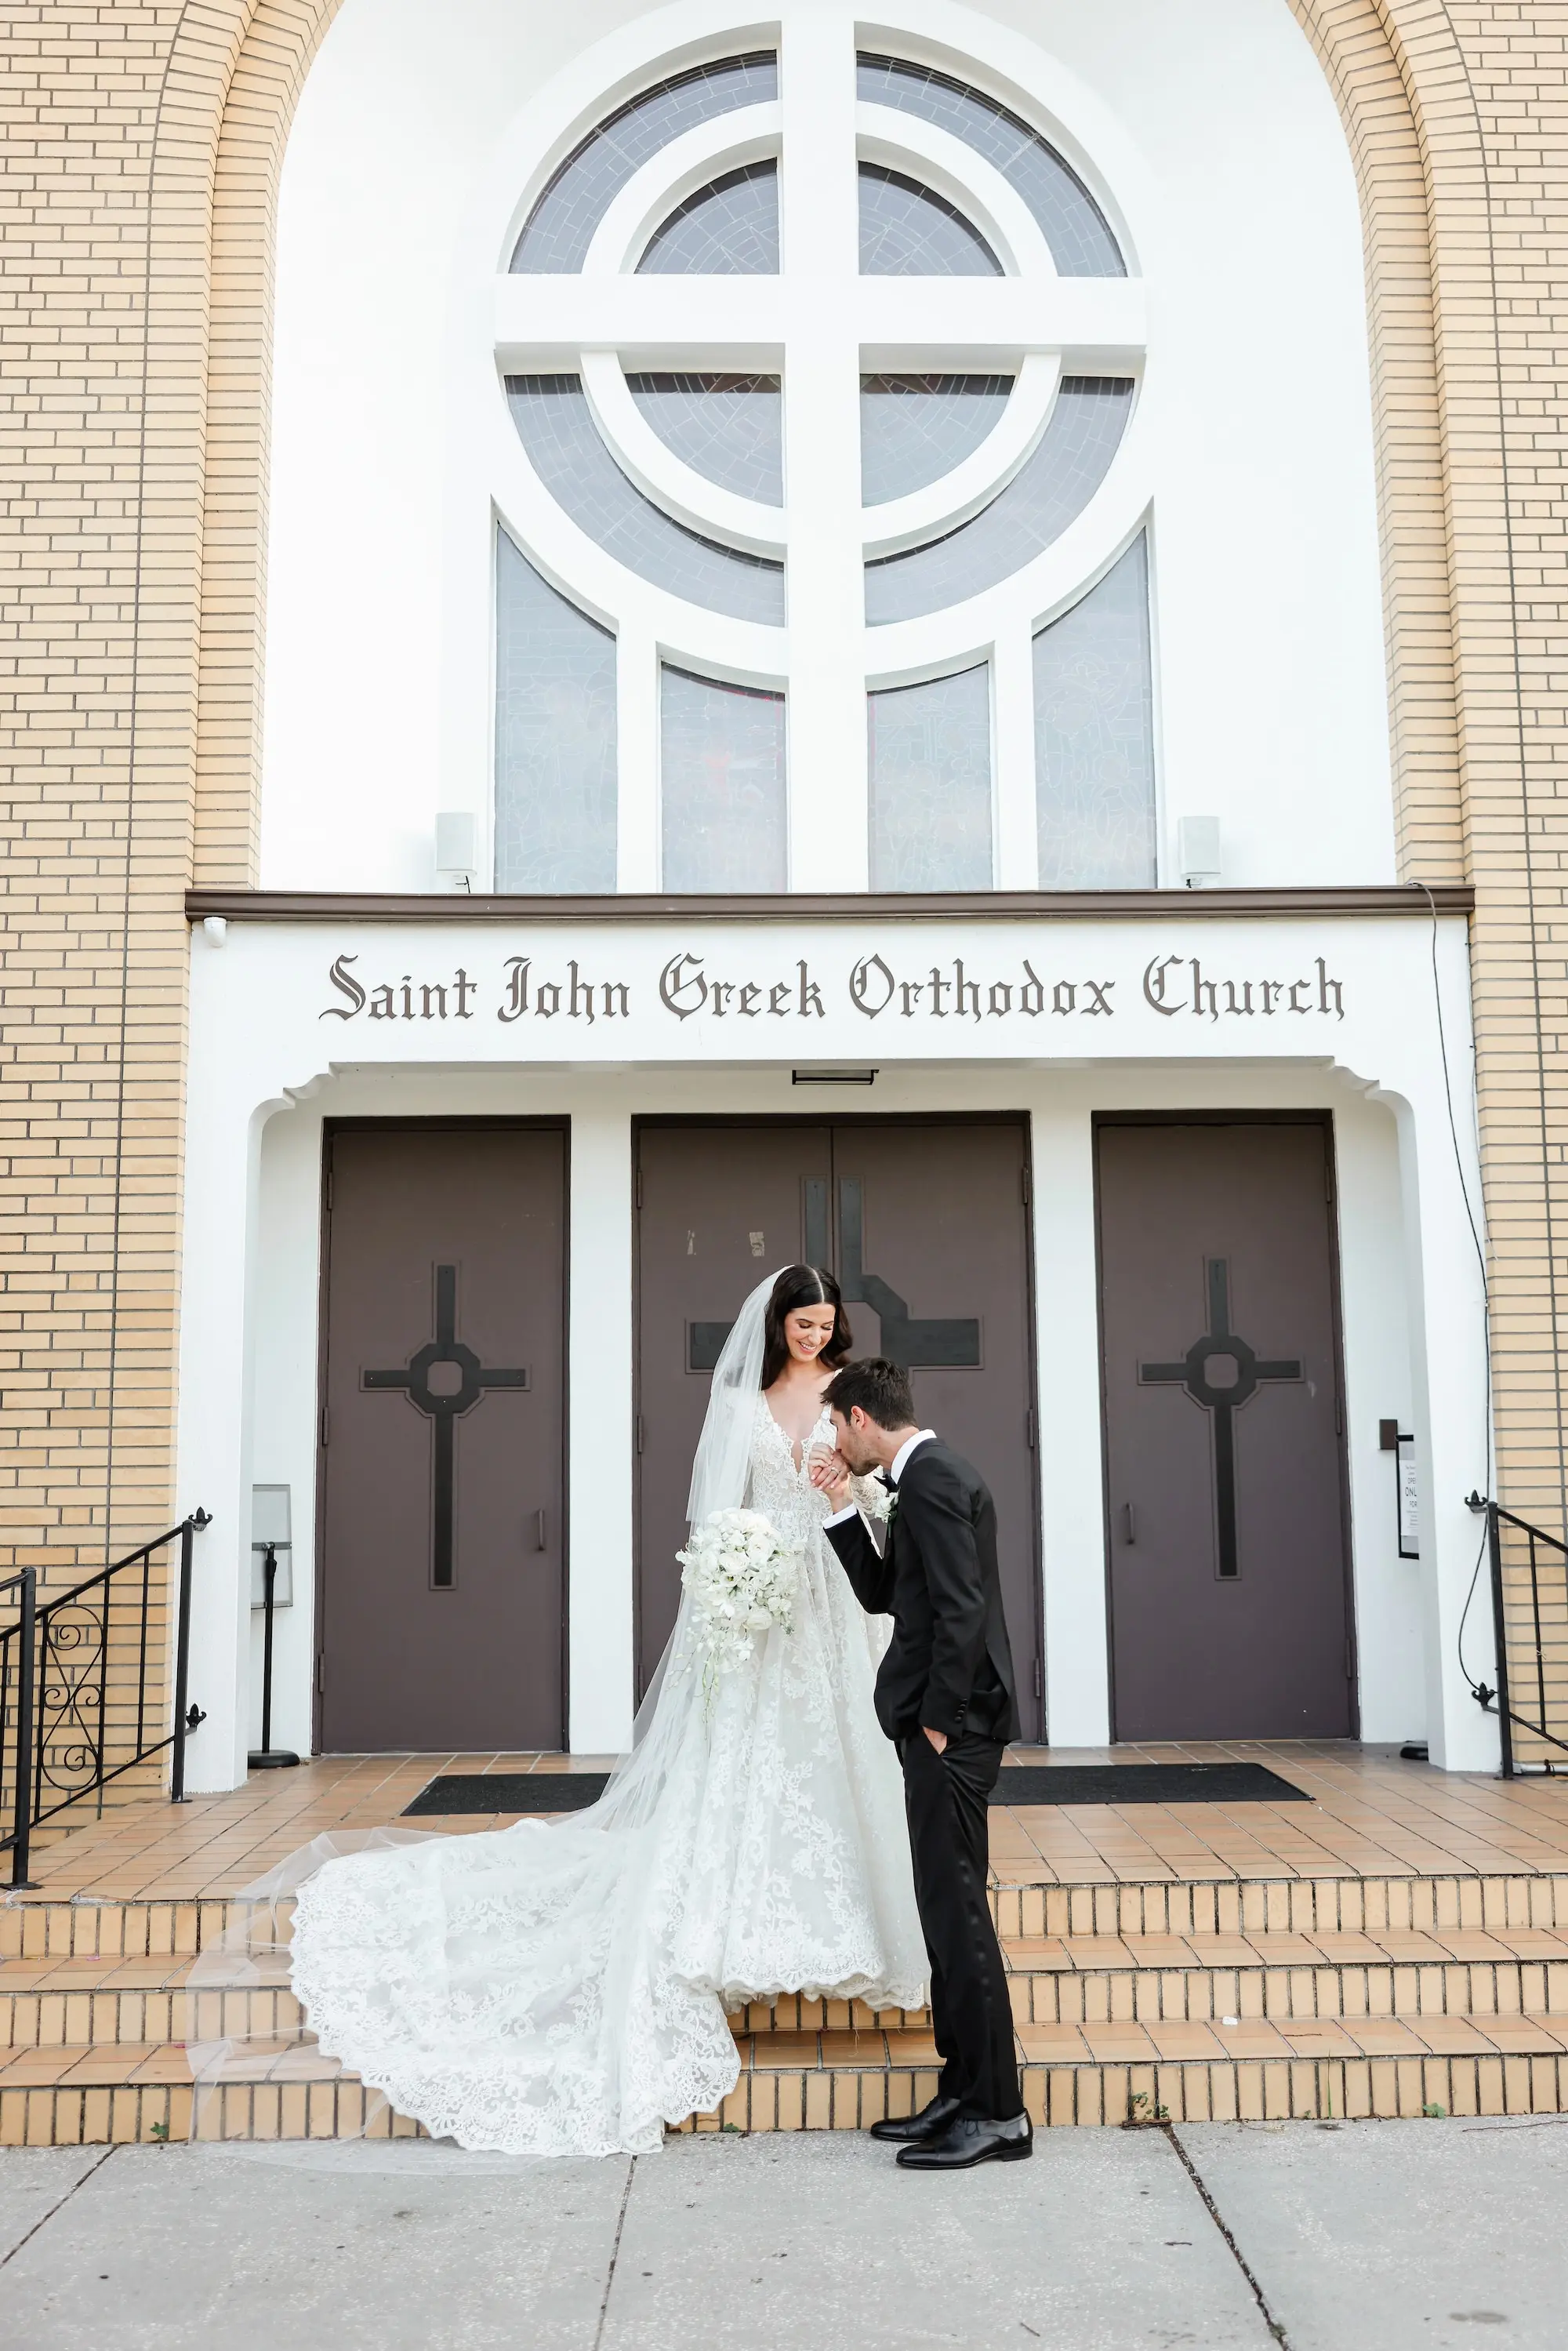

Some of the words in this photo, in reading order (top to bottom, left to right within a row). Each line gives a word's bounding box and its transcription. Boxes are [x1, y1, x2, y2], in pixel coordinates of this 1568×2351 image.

[318, 954, 477, 1021] Saint
[497, 956, 630, 1026] John
[659, 952, 826, 1022] Greek
[849, 953, 1116, 1023] Orthodox
[1143, 954, 1345, 1023] Church
[1404, 1486, 1417, 1497] ONL
